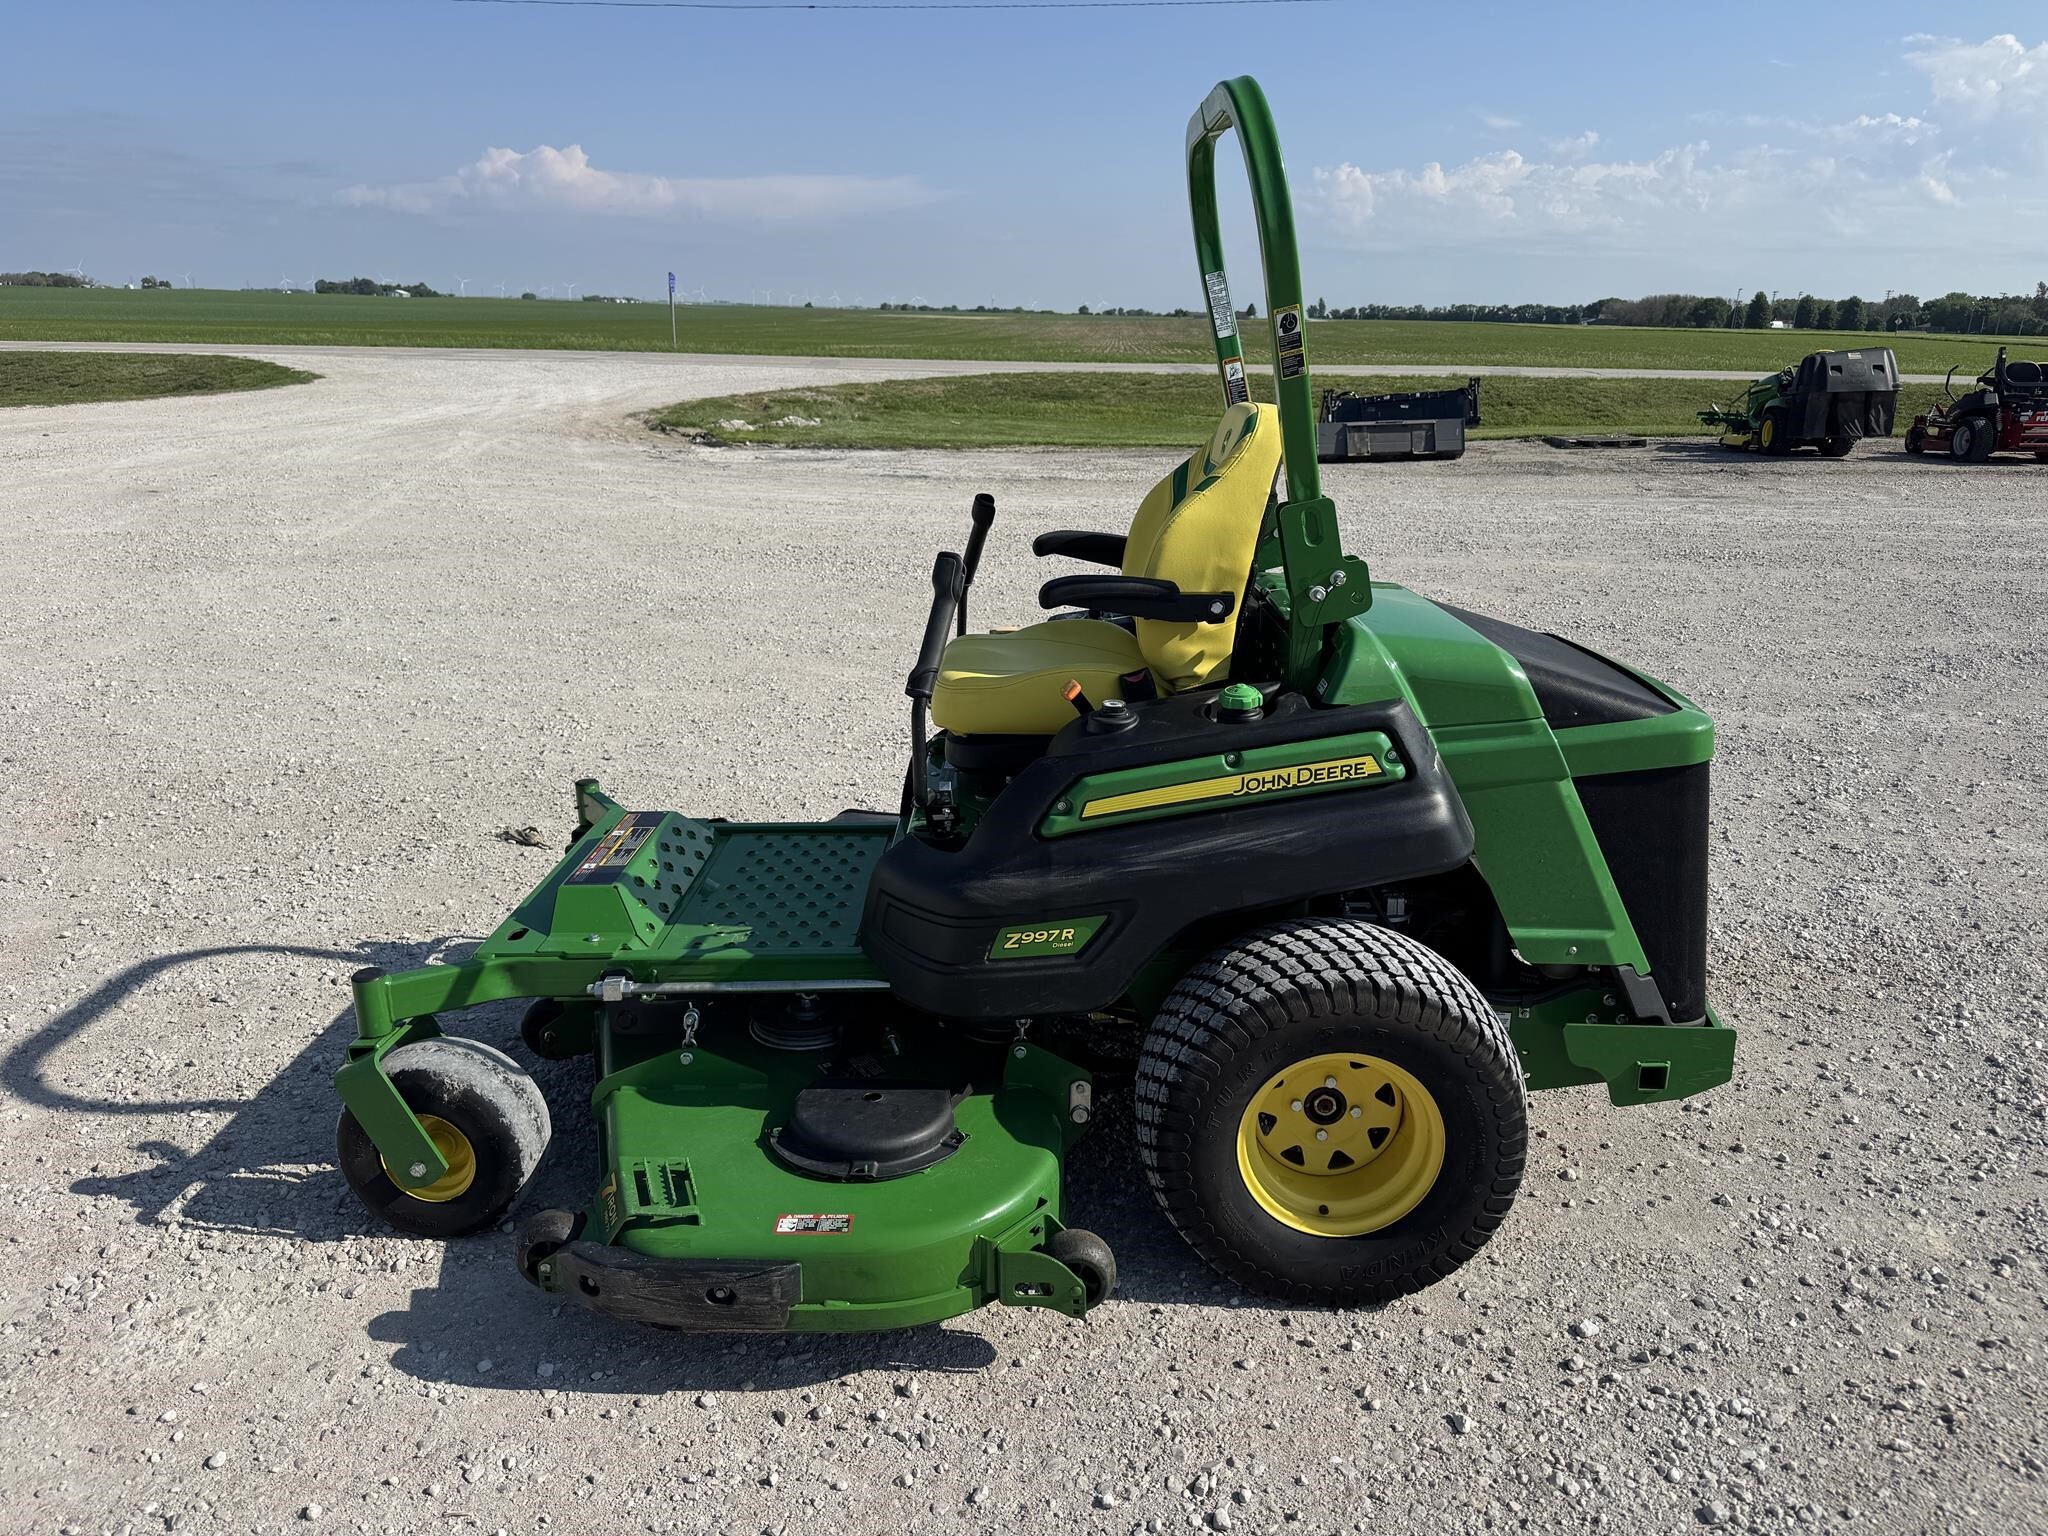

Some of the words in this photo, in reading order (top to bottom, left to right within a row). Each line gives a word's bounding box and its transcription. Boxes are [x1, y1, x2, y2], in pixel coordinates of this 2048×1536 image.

[1233, 772, 1291, 795] JOHN
[1297, 761, 1367, 786] DEERE
[1004, 928, 1075, 948] Z997R
[607, 1192, 618, 1226] IRON
